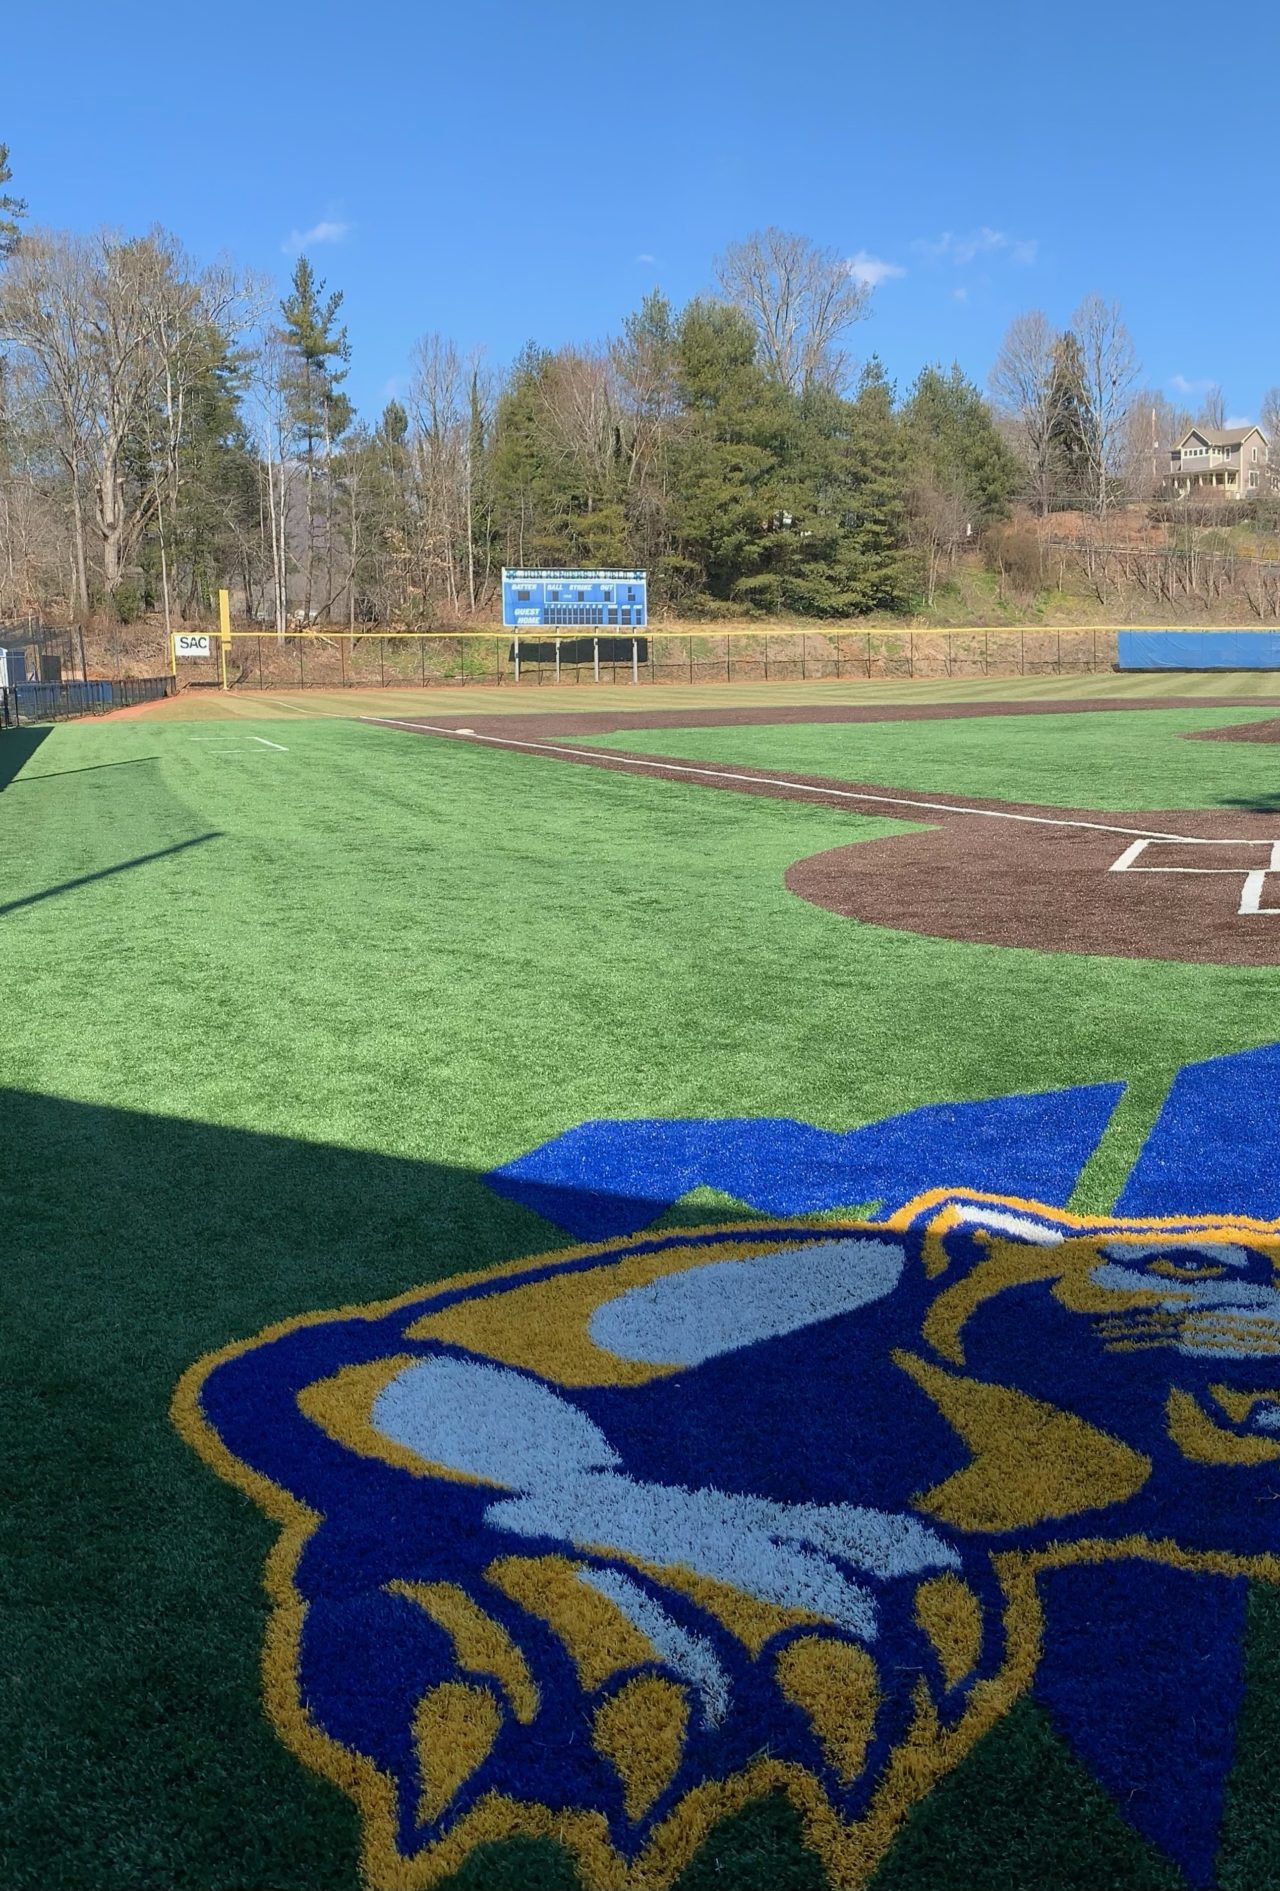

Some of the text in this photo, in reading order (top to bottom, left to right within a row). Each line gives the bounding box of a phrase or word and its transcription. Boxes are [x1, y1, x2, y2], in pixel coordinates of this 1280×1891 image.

[514, 608, 541, 616] GUEST
[517, 617, 541, 625] HOME
[180, 636, 207, 649] SAC
